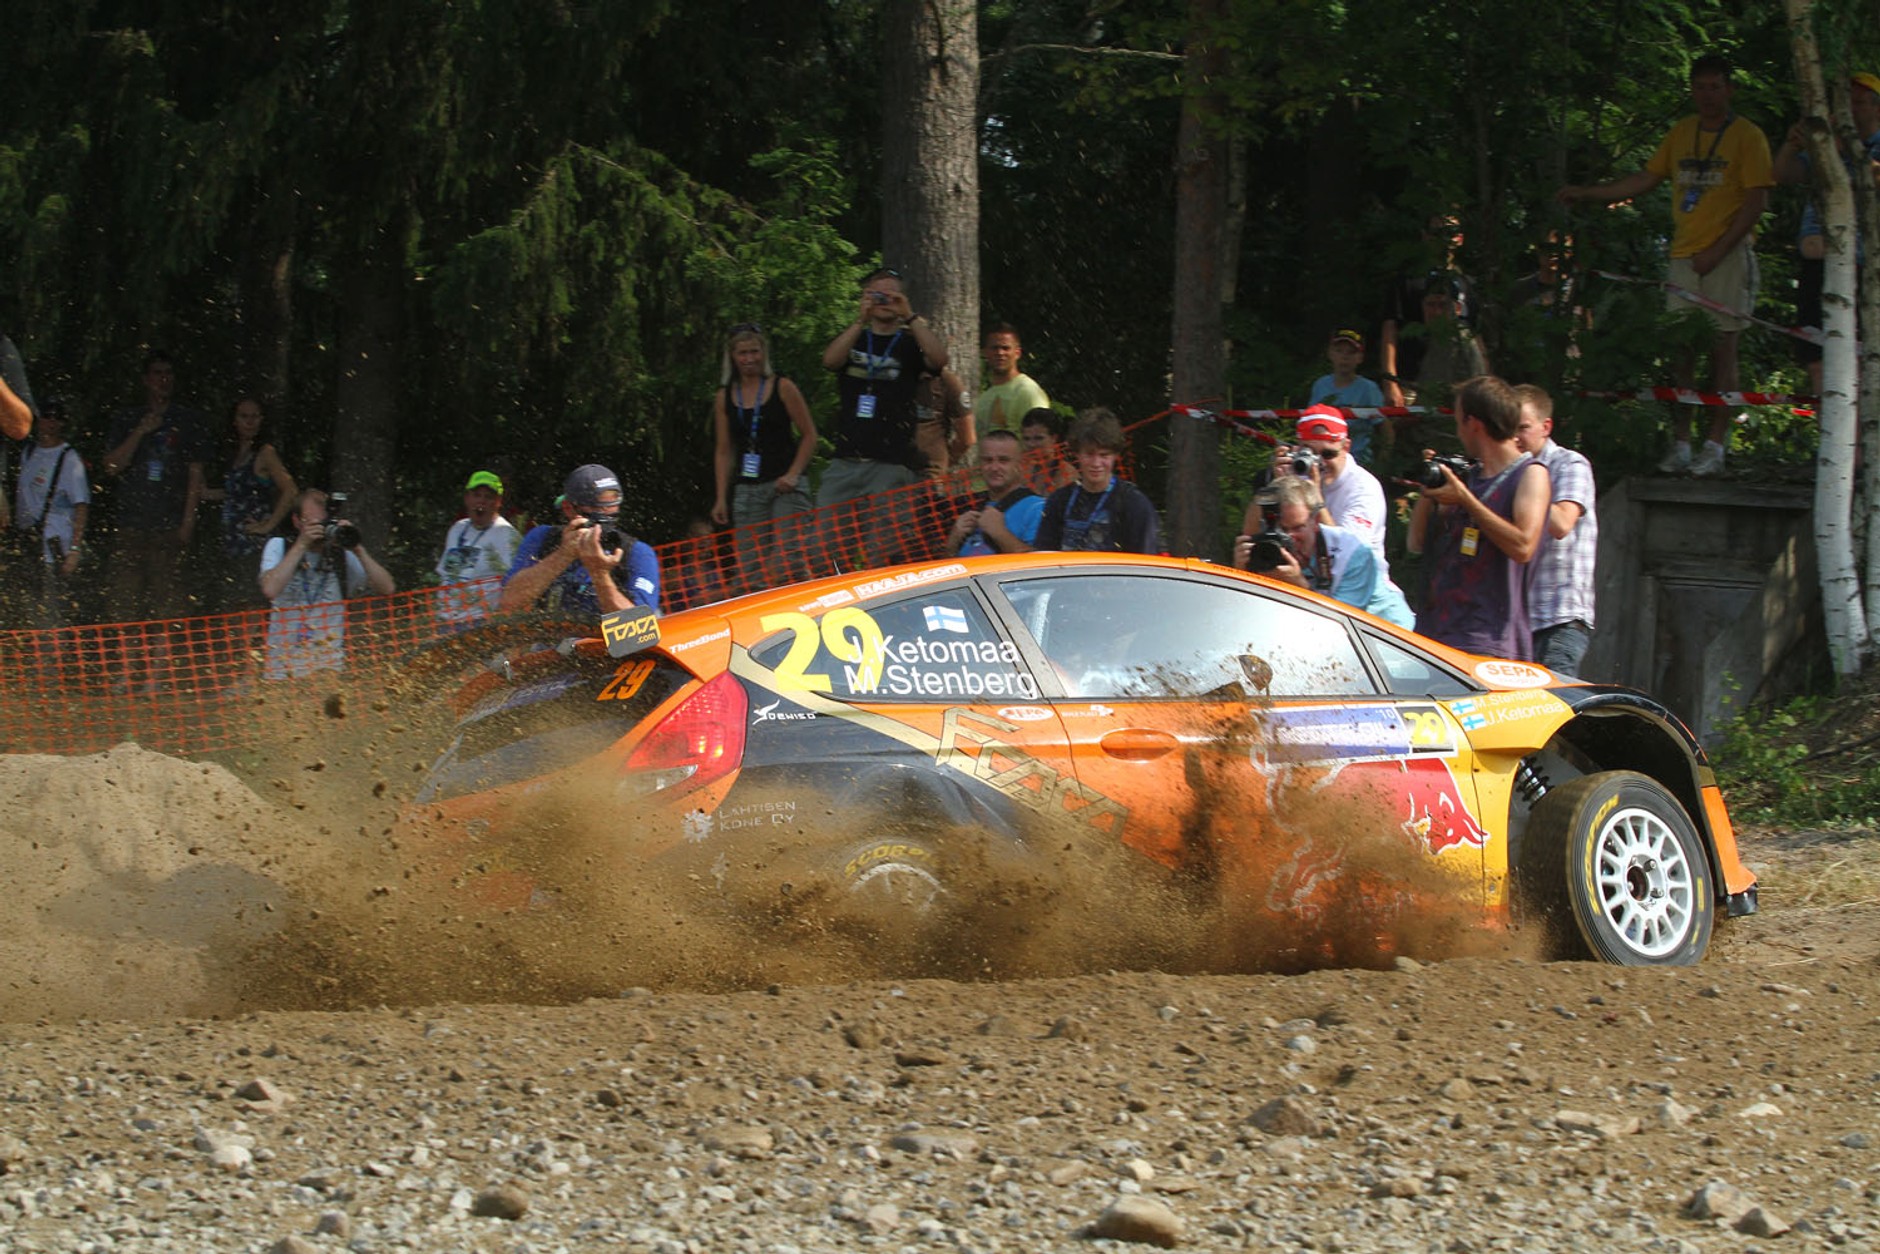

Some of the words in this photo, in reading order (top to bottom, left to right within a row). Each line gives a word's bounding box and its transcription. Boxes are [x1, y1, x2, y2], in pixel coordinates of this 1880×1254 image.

[668, 628, 731, 654] ThreeBond
[759, 607, 885, 693] 29
[848, 634, 1021, 664] J.Ketomaa
[596, 659, 657, 700] 29
[843, 664, 1038, 700] M.Stenberg
[1486, 663, 1539, 677] SEPA
[1485, 701, 1566, 725] J.Ketomaa
[1402, 711, 1447, 745] 29
[719, 801, 796, 819] LAHTISEN
[719, 816, 763, 832] KONE
